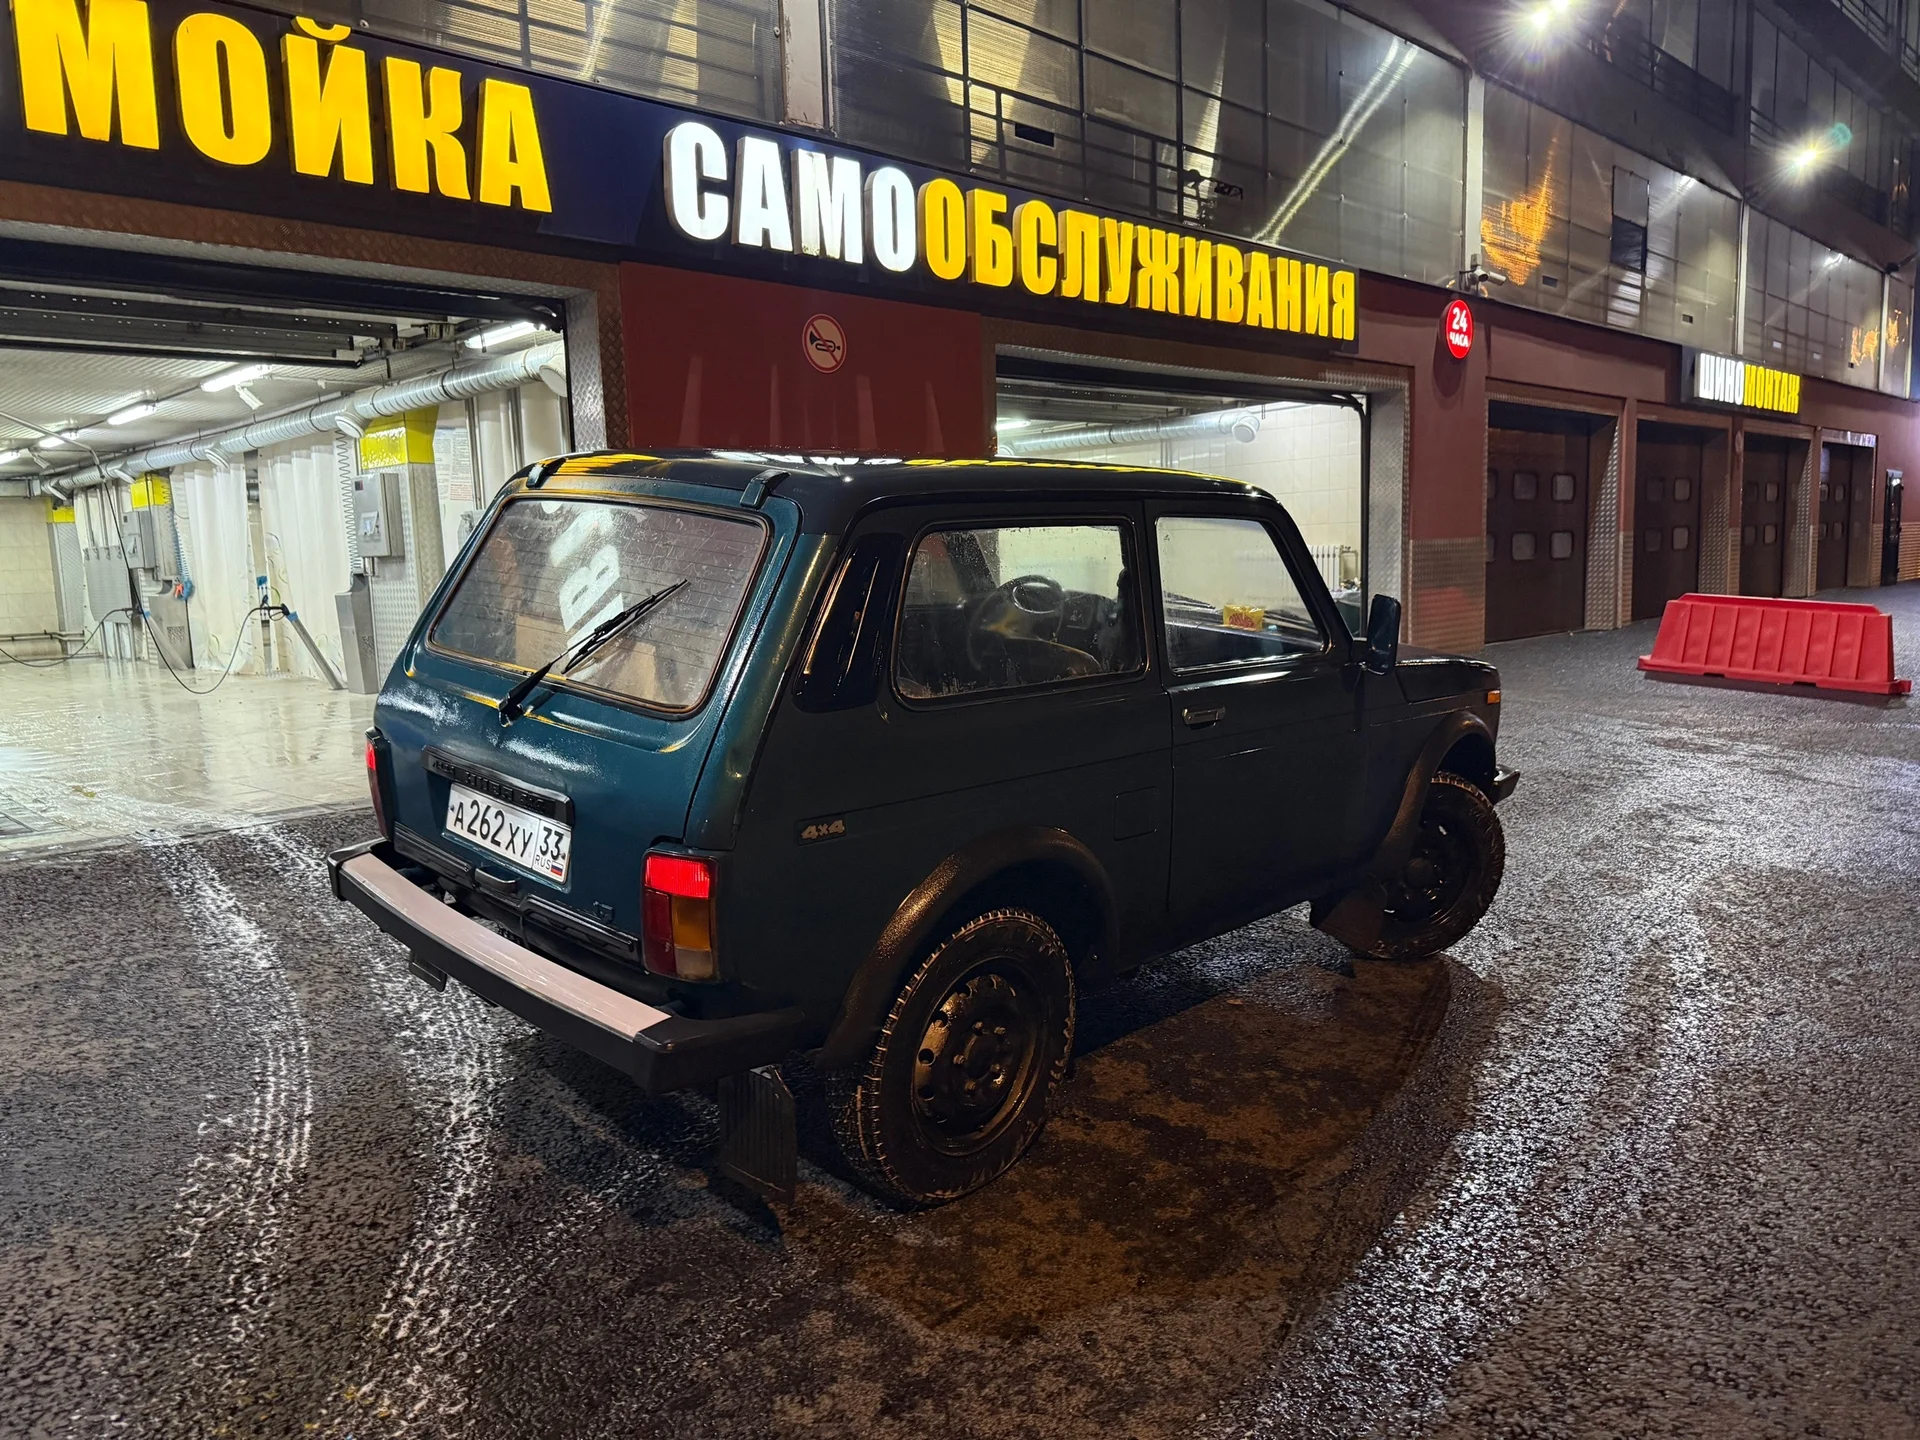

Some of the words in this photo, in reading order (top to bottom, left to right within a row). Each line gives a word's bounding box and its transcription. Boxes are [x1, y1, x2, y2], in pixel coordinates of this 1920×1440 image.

[11, 0, 553, 213] МОЙКА
[663, 121, 1357, 341] САМООБСЛУЖИВАНИЯ
[1452, 307, 1468, 332] 24
[1449, 331, 1469, 348] ЧАСА
[1698, 353, 1801, 414] ШИНОМОНТАЖ
[539, 826, 565, 861] 33
[534, 854, 552, 871] RUS
